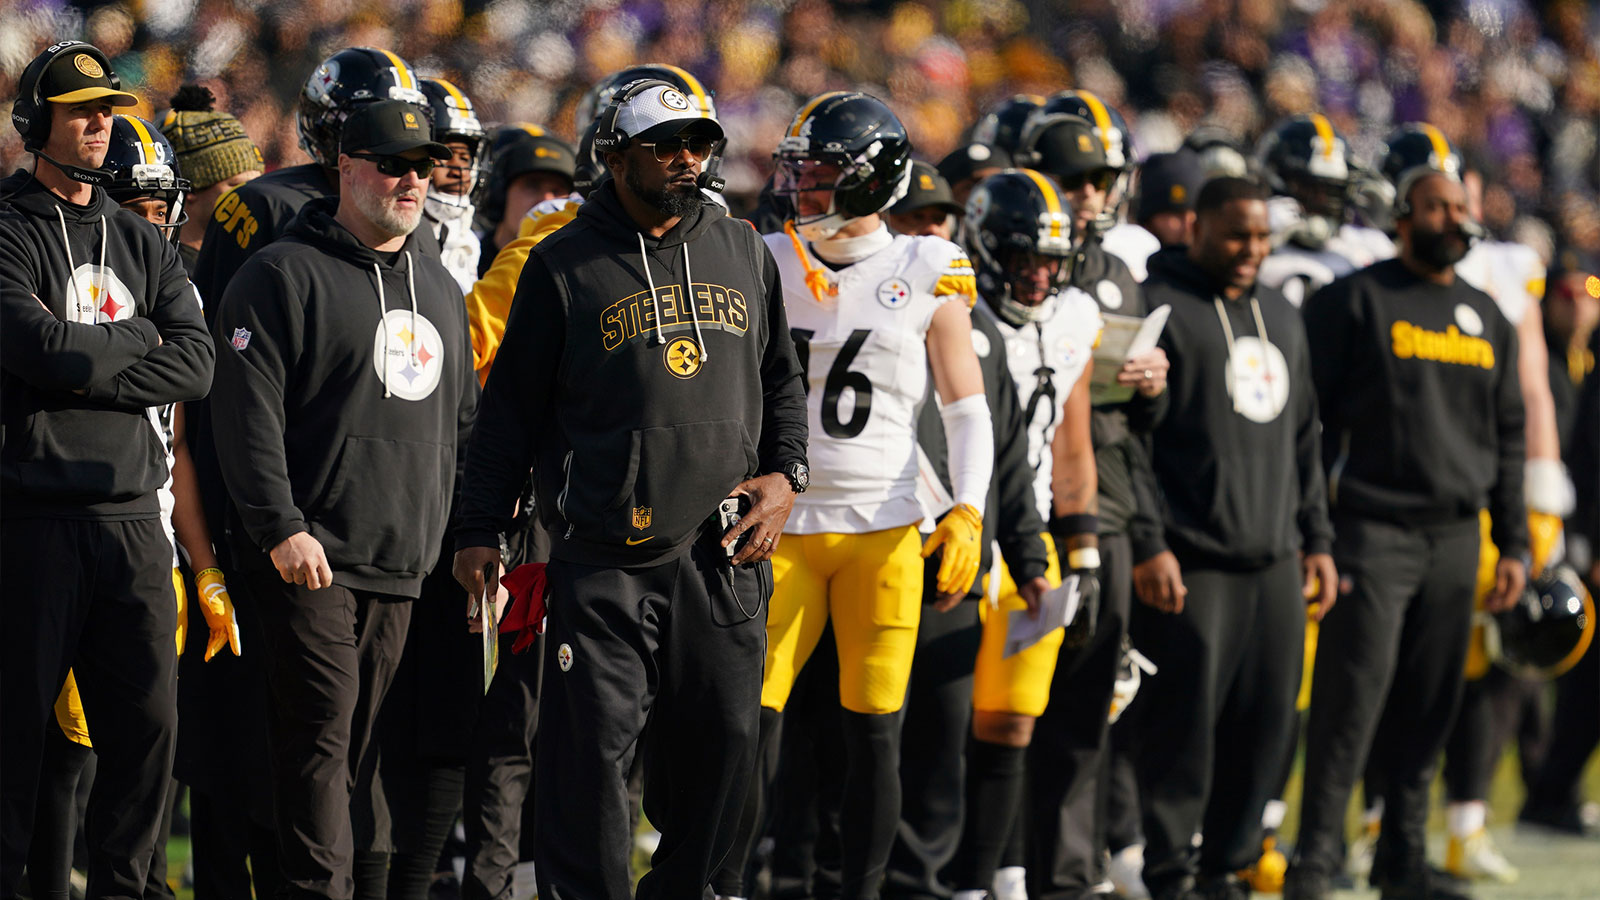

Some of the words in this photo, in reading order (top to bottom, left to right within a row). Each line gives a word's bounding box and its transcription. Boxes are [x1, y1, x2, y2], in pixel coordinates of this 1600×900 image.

[48, 40, 84, 53] SON
[12, 113, 30, 125] SONY
[596, 138, 615, 146] SONY
[133, 141, 165, 165] 19
[73, 172, 102, 183] SONY
[600, 283, 749, 351] STEELERS
[1391, 320, 1495, 370] Steelers
[635, 516, 649, 526] NFL
